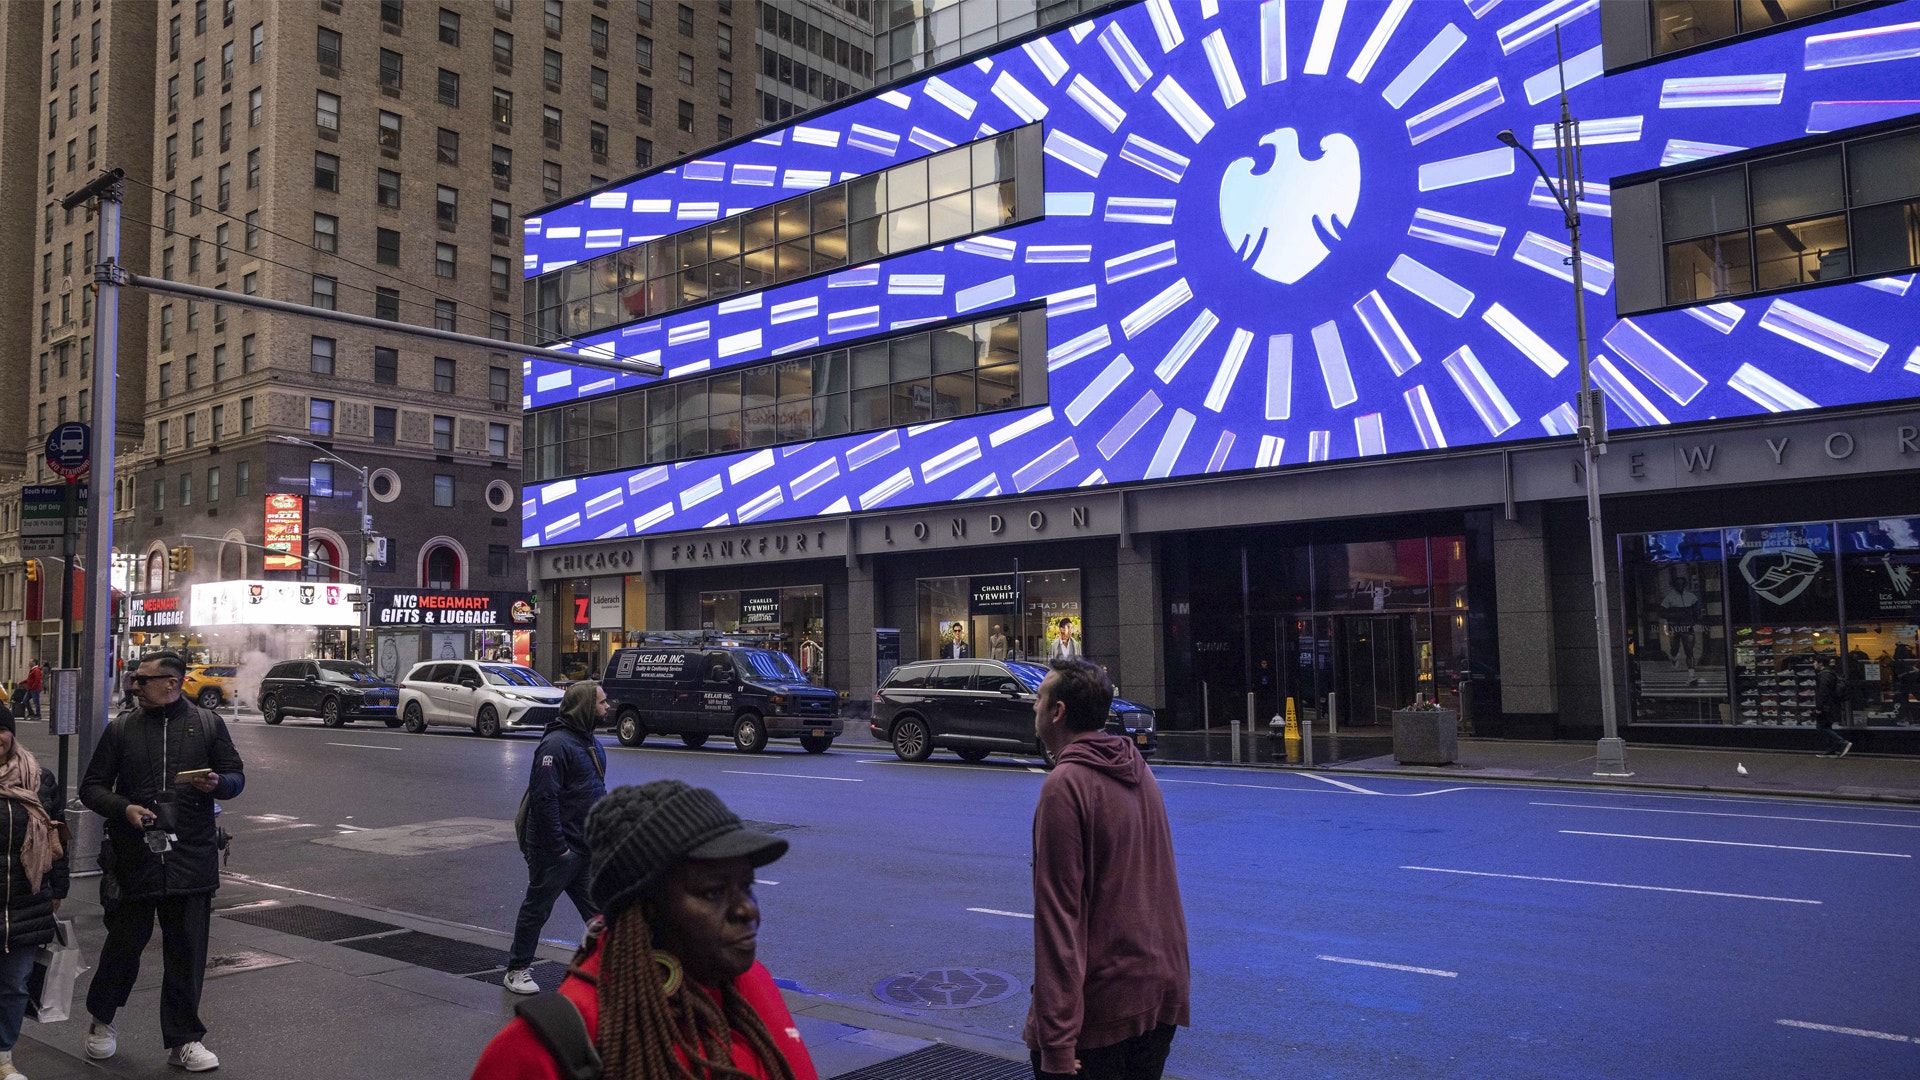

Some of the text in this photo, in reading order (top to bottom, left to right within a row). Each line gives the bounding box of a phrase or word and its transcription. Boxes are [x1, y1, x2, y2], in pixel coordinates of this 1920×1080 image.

[50, 461, 60, 470] NO
[1571, 444, 1716, 485] NEW
[883, 506, 1090, 545] LONDON
[1761, 530, 1798, 540] Super
[1794, 536, 1822, 546] Shop
[672, 529, 826, 562] FRANKFURT
[552, 547, 634, 573] CHICAGO
[393, 594, 490, 609] NYC MEGAMART
[593, 595, 620, 605] Läderach
[973, 592, 1020, 601] TYRWHITT
[132, 597, 179, 612] NYC MEGAMART
[146, 614, 152, 626] &
[154, 611, 184, 626] LUGGAGE
[380, 608, 496, 624] GIFTS & LUGGAGE
[1670, 625, 1691, 634] your
[638, 654, 685, 663] KELAIR INC.
